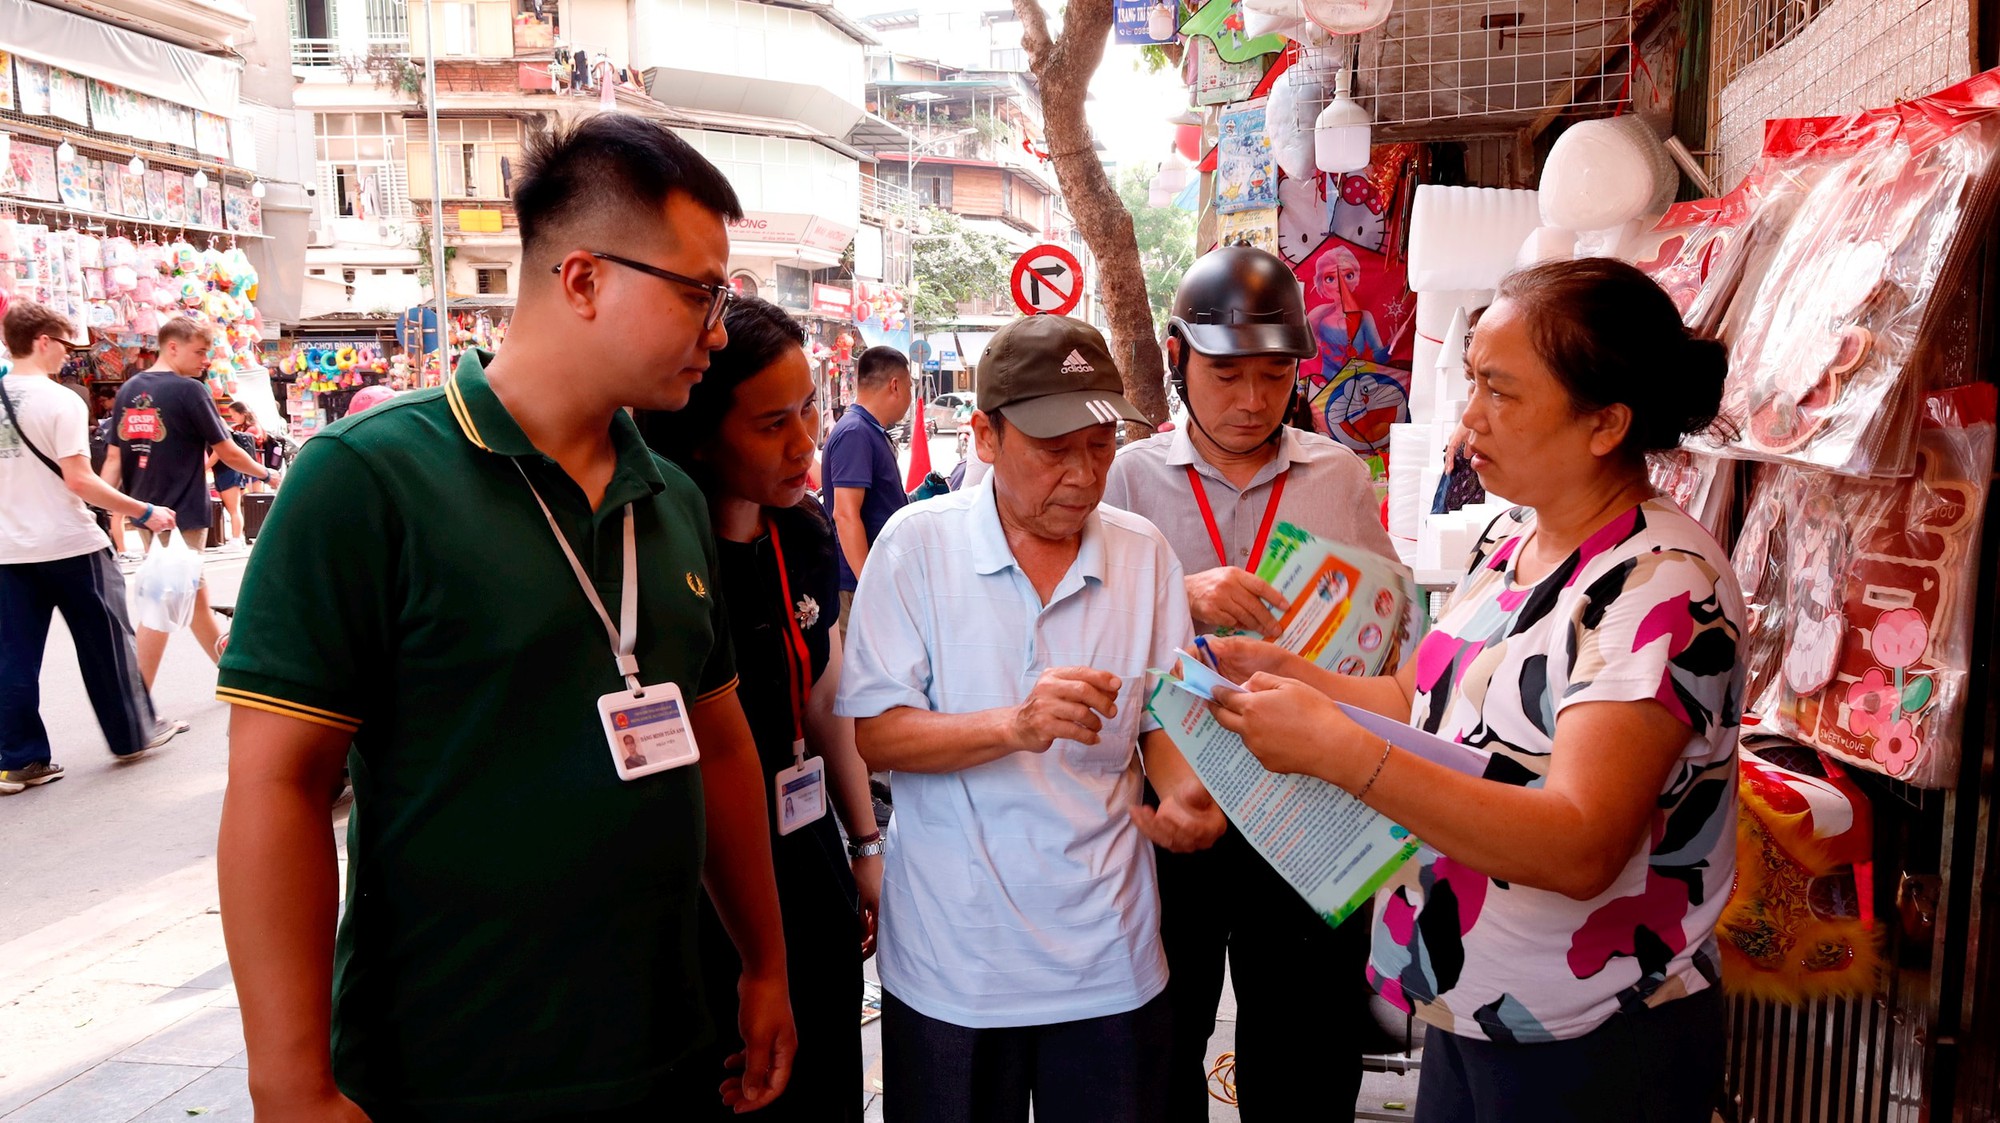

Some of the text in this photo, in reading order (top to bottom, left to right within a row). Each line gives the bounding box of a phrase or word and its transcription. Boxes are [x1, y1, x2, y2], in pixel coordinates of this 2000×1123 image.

[1061, 364, 1095, 374] adidas
[1819, 728, 1865, 754] SWEET LOVE
